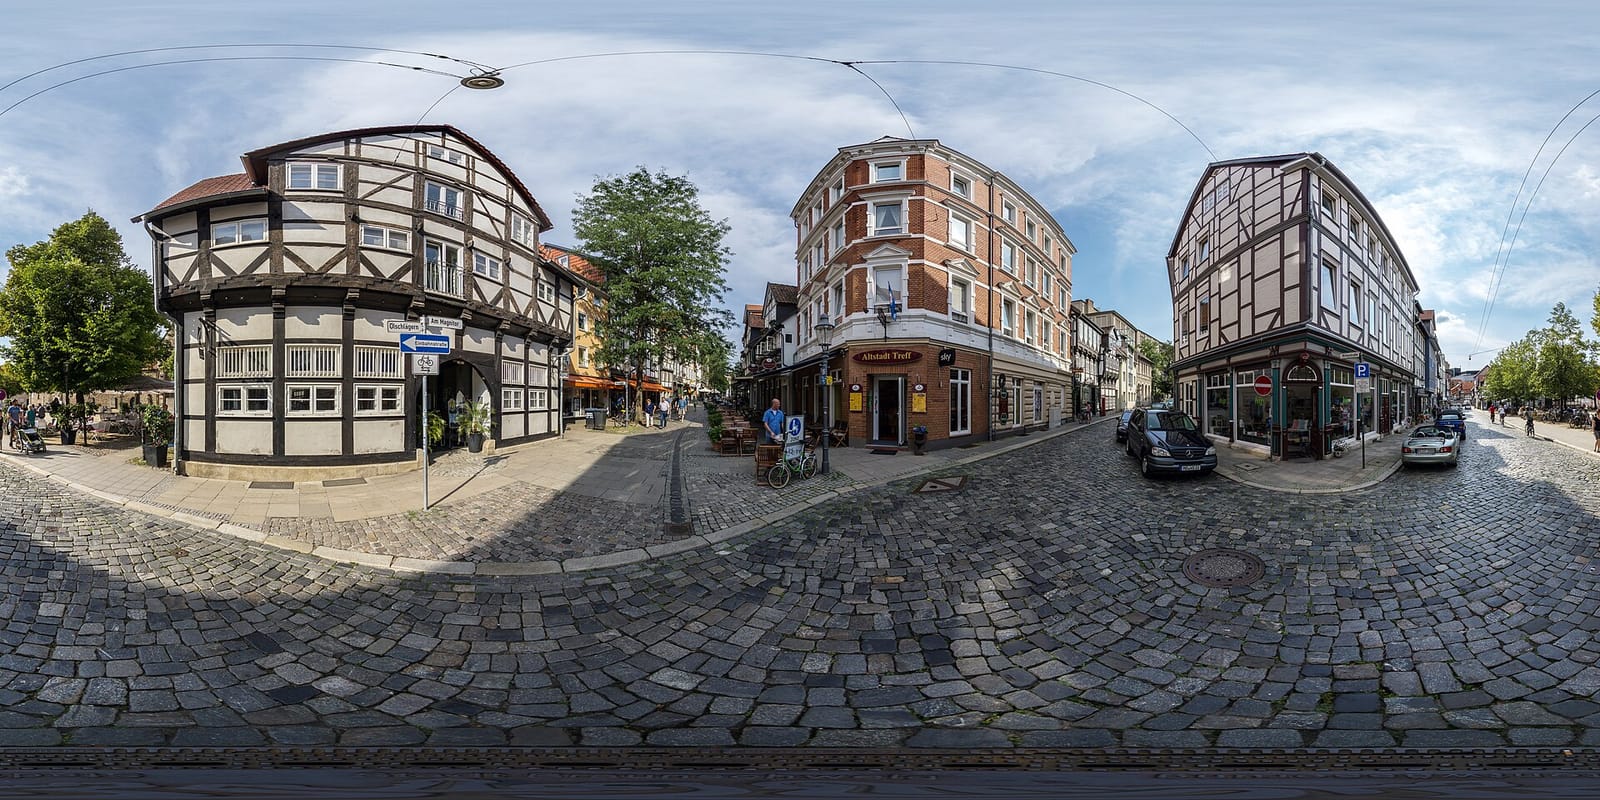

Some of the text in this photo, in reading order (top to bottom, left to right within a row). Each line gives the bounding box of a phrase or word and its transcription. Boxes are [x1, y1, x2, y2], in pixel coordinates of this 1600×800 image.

[862, 352, 912, 360] Altstadt Treff
[940, 352, 952, 361] sky
[1358, 364, 1366, 376] P
